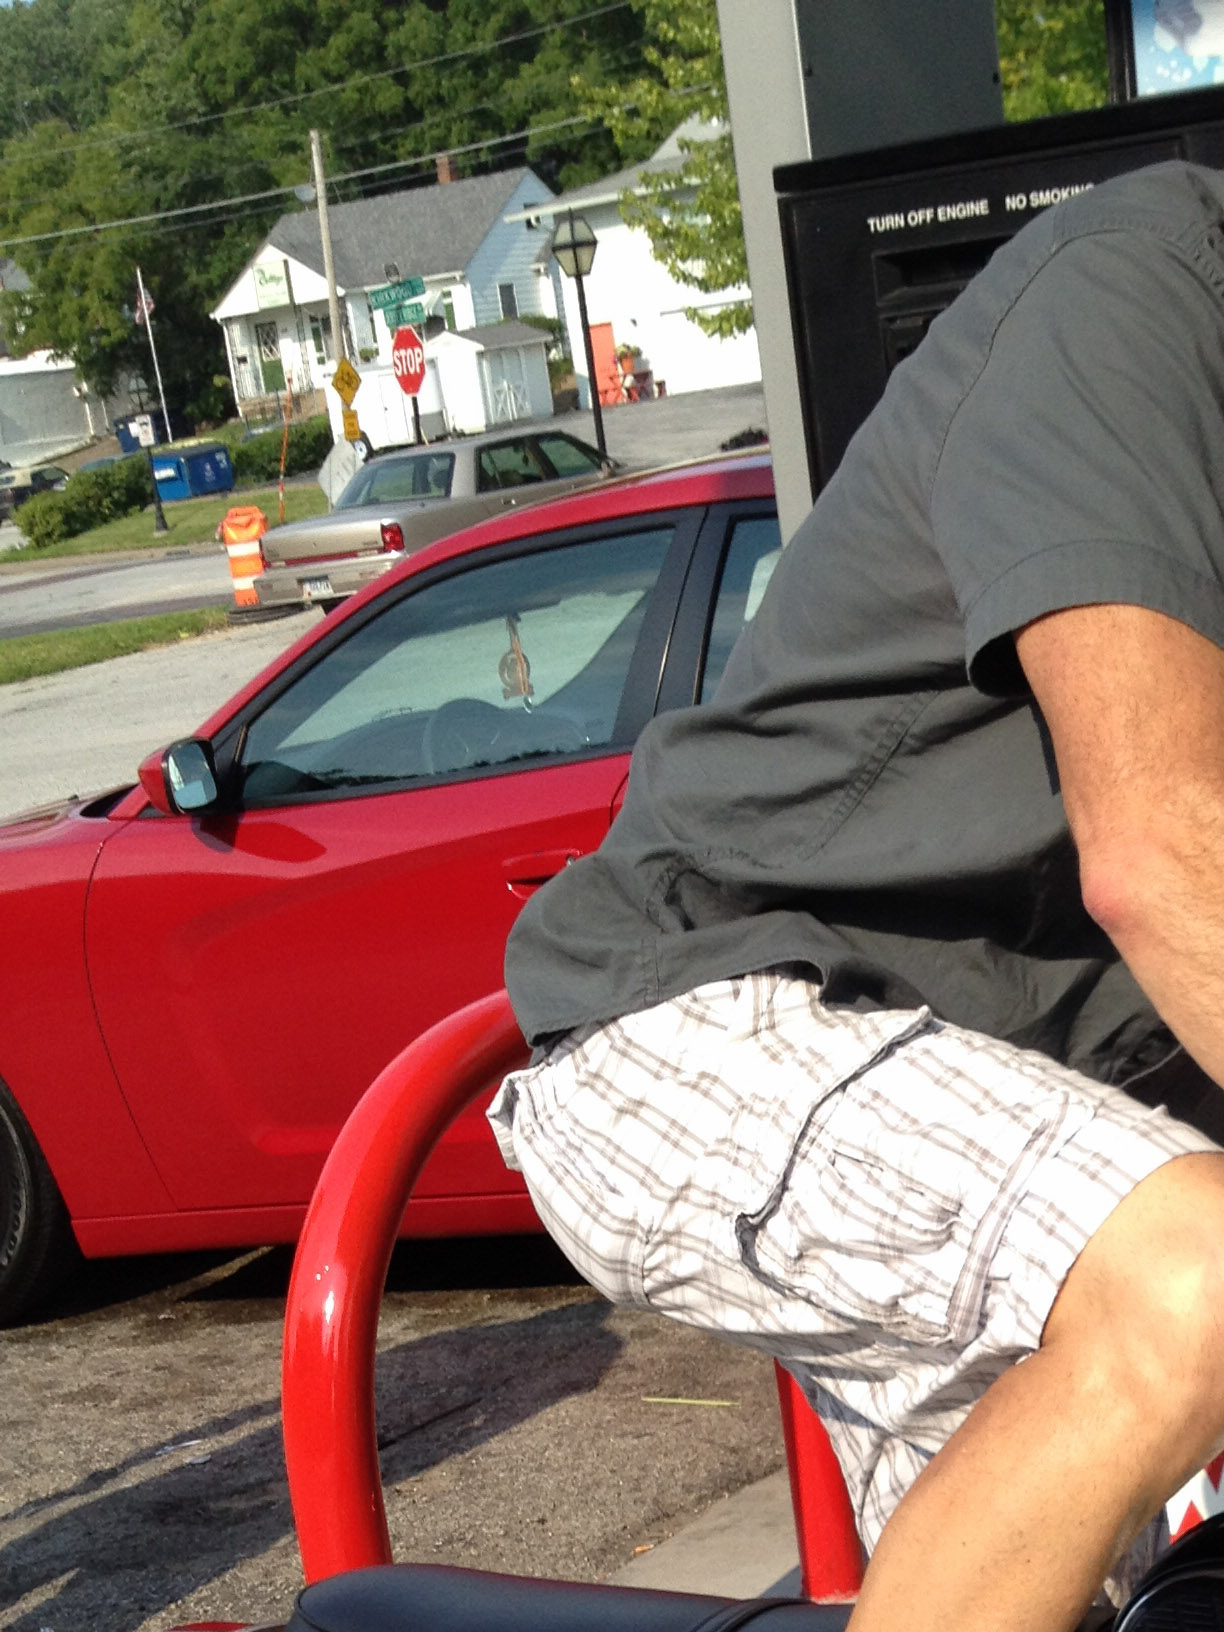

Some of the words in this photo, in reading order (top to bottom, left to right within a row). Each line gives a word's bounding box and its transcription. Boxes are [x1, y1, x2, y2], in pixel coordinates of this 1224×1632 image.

[867, 213, 905, 234] TURN
[907, 207, 935, 227] OFF
[937, 198, 990, 223] ENGINE
[1005, 193, 1028, 212] NO
[393, 346, 423, 377] STOP
